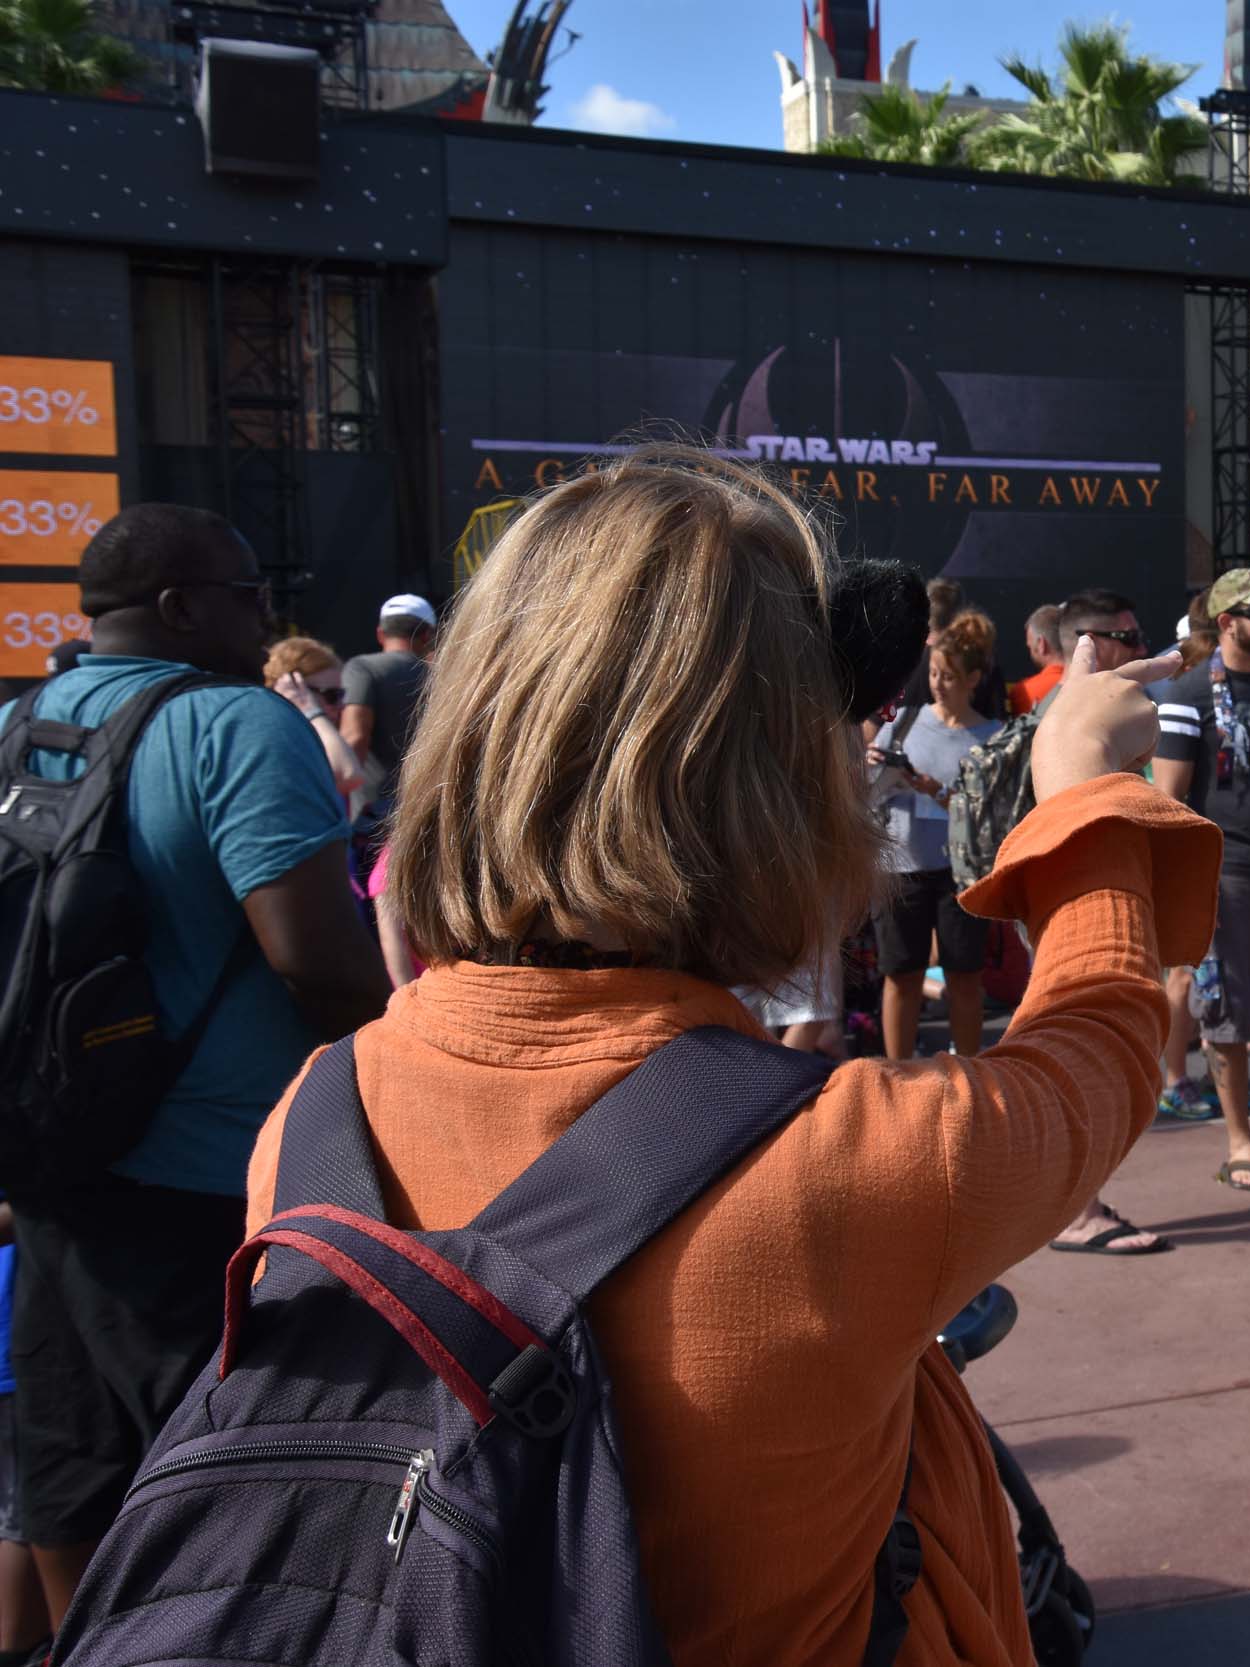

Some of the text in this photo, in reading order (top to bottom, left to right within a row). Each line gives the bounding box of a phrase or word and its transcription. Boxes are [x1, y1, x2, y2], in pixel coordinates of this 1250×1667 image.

[745, 435, 938, 466] STAR WARS
[474, 458, 504, 489] A
[927, 472, 1012, 504] FAR
[1040, 475, 1161, 508] AWAY
